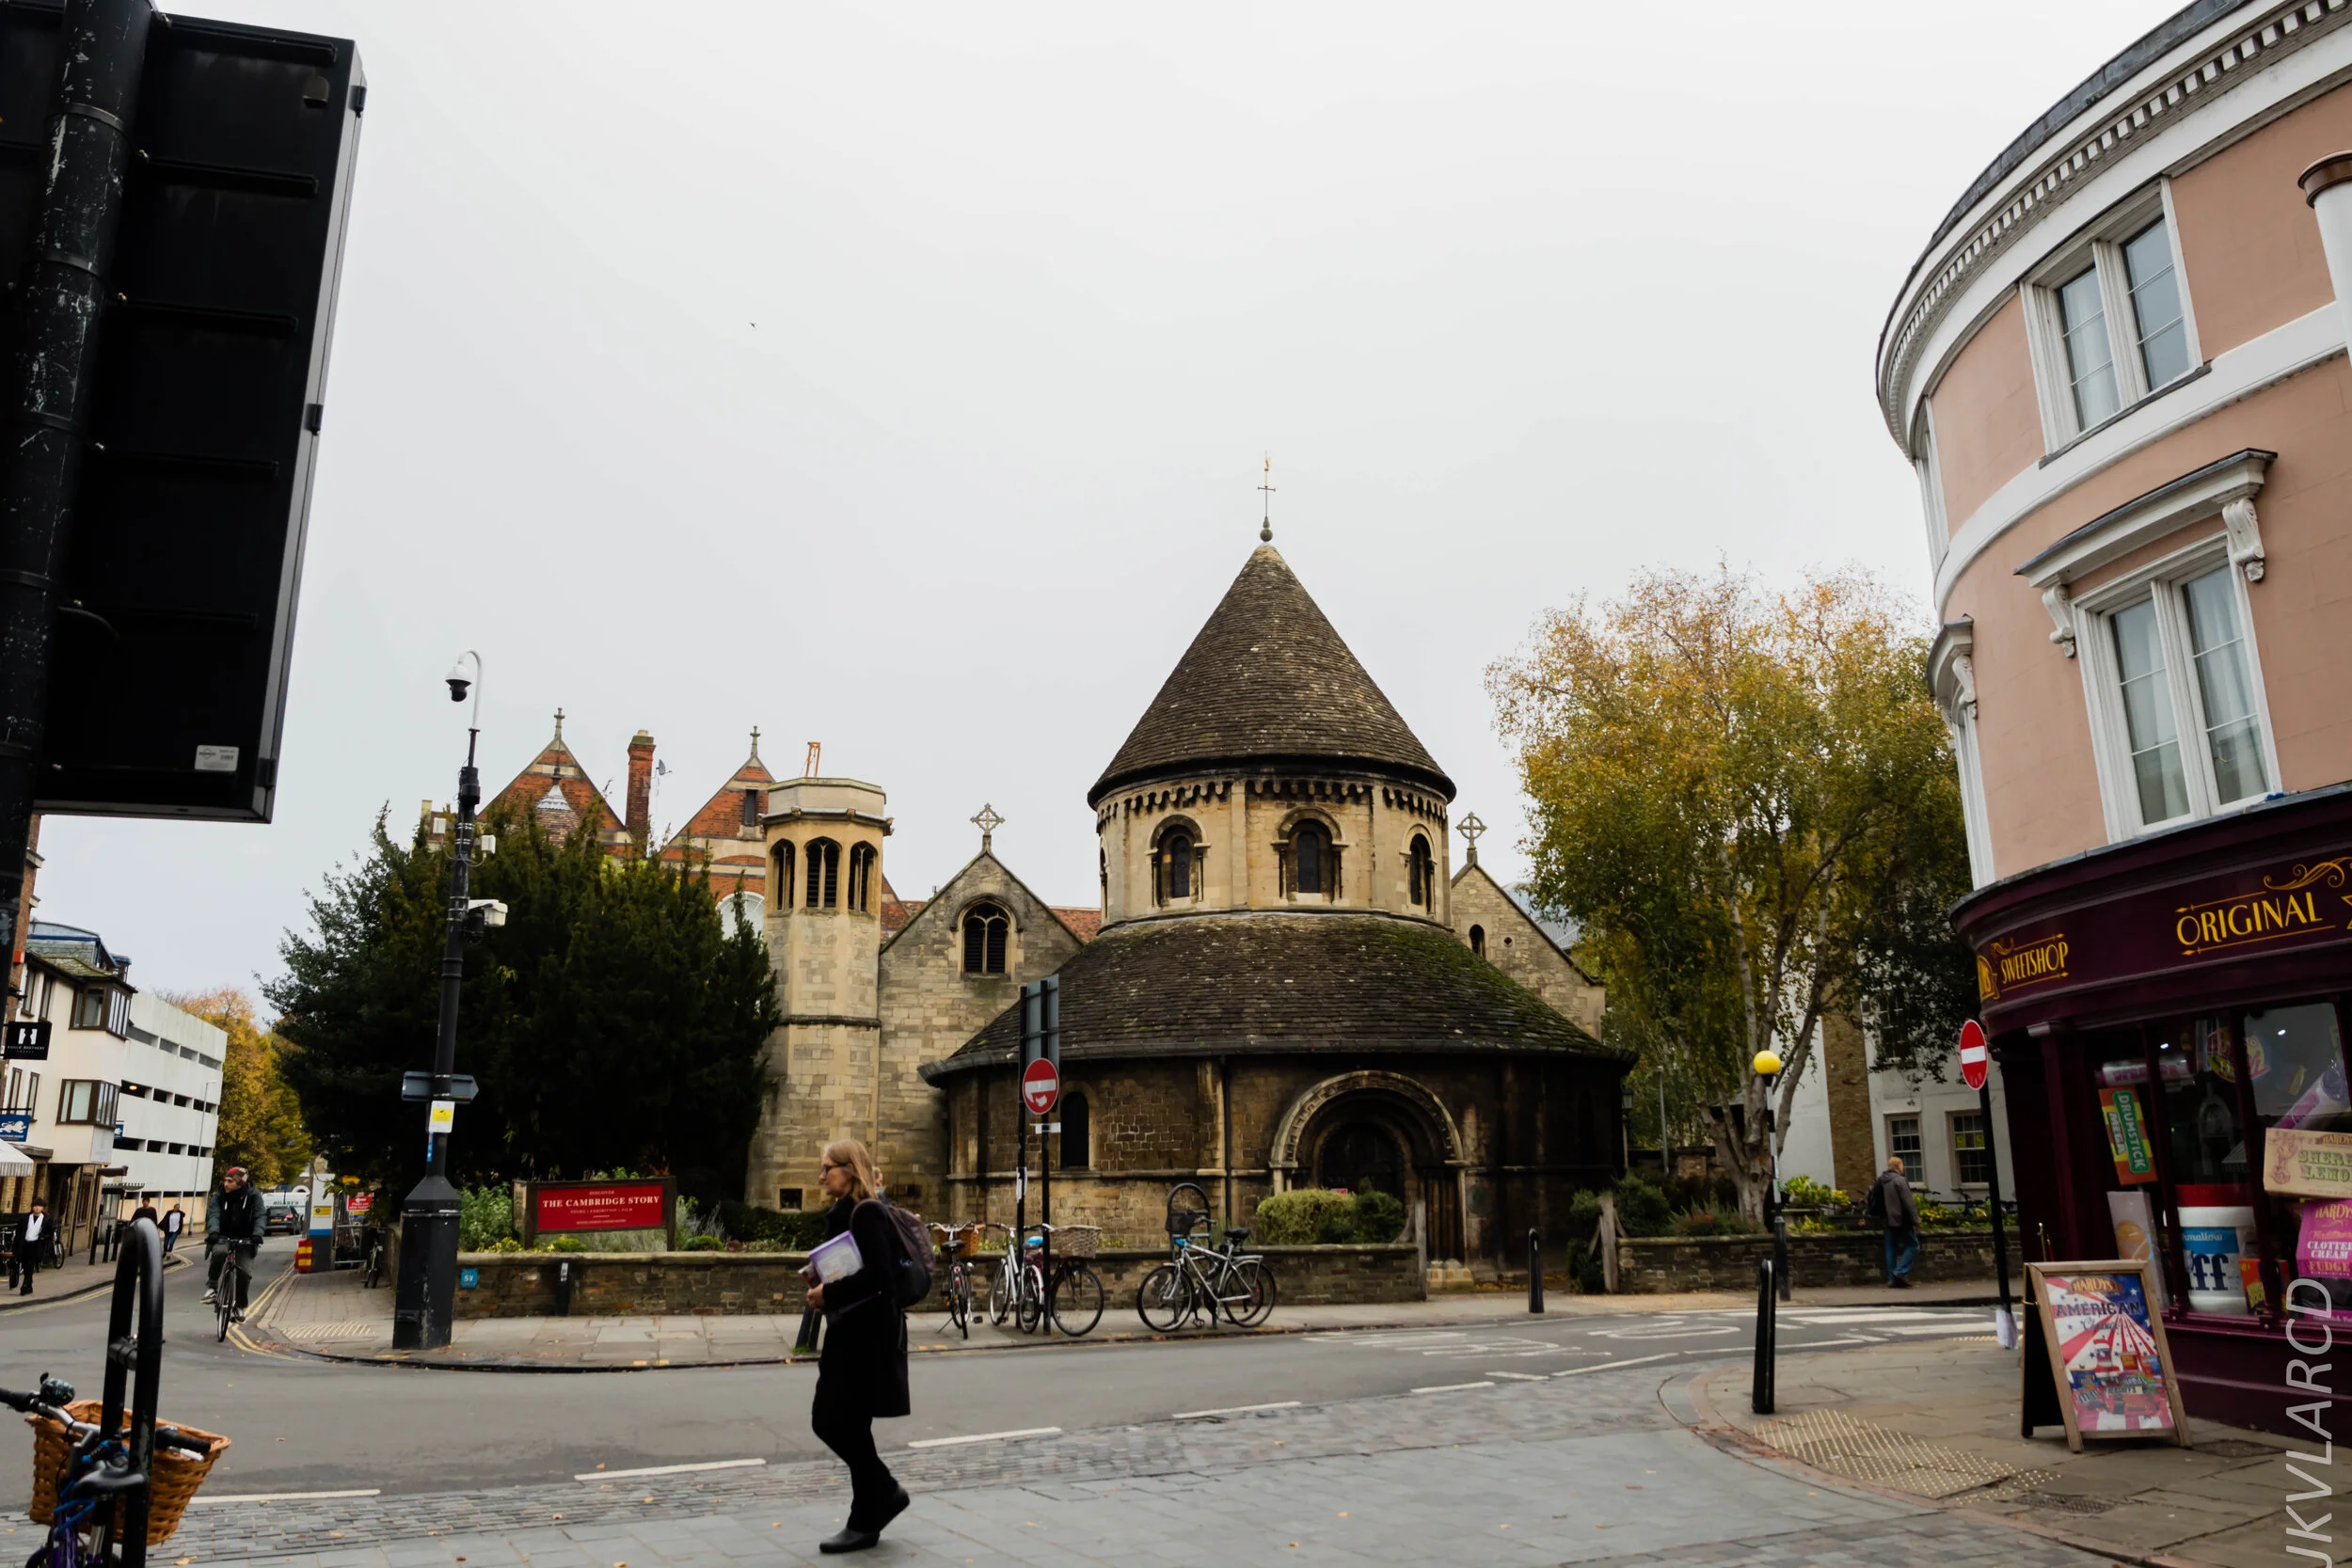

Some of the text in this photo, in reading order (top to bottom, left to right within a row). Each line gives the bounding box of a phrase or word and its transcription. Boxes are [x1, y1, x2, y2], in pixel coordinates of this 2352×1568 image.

[2176, 891, 2323, 946] ORIGINAL
[2000, 941, 2069, 985] SWEETSHOP
[2108, 1112, 2126, 1155] MEGA
[2118, 1094, 2146, 1169] DRUMSTICK
[2305, 1164, 2352, 1182] LEMO
[543, 1196, 660, 1208] THE CAMBRIDGE STORY
[2311, 1250, 2348, 1259] CREAM
[2309, 1260, 2350, 1273] FUDGE
[2056, 1302, 2140, 1317] AMERICAN
